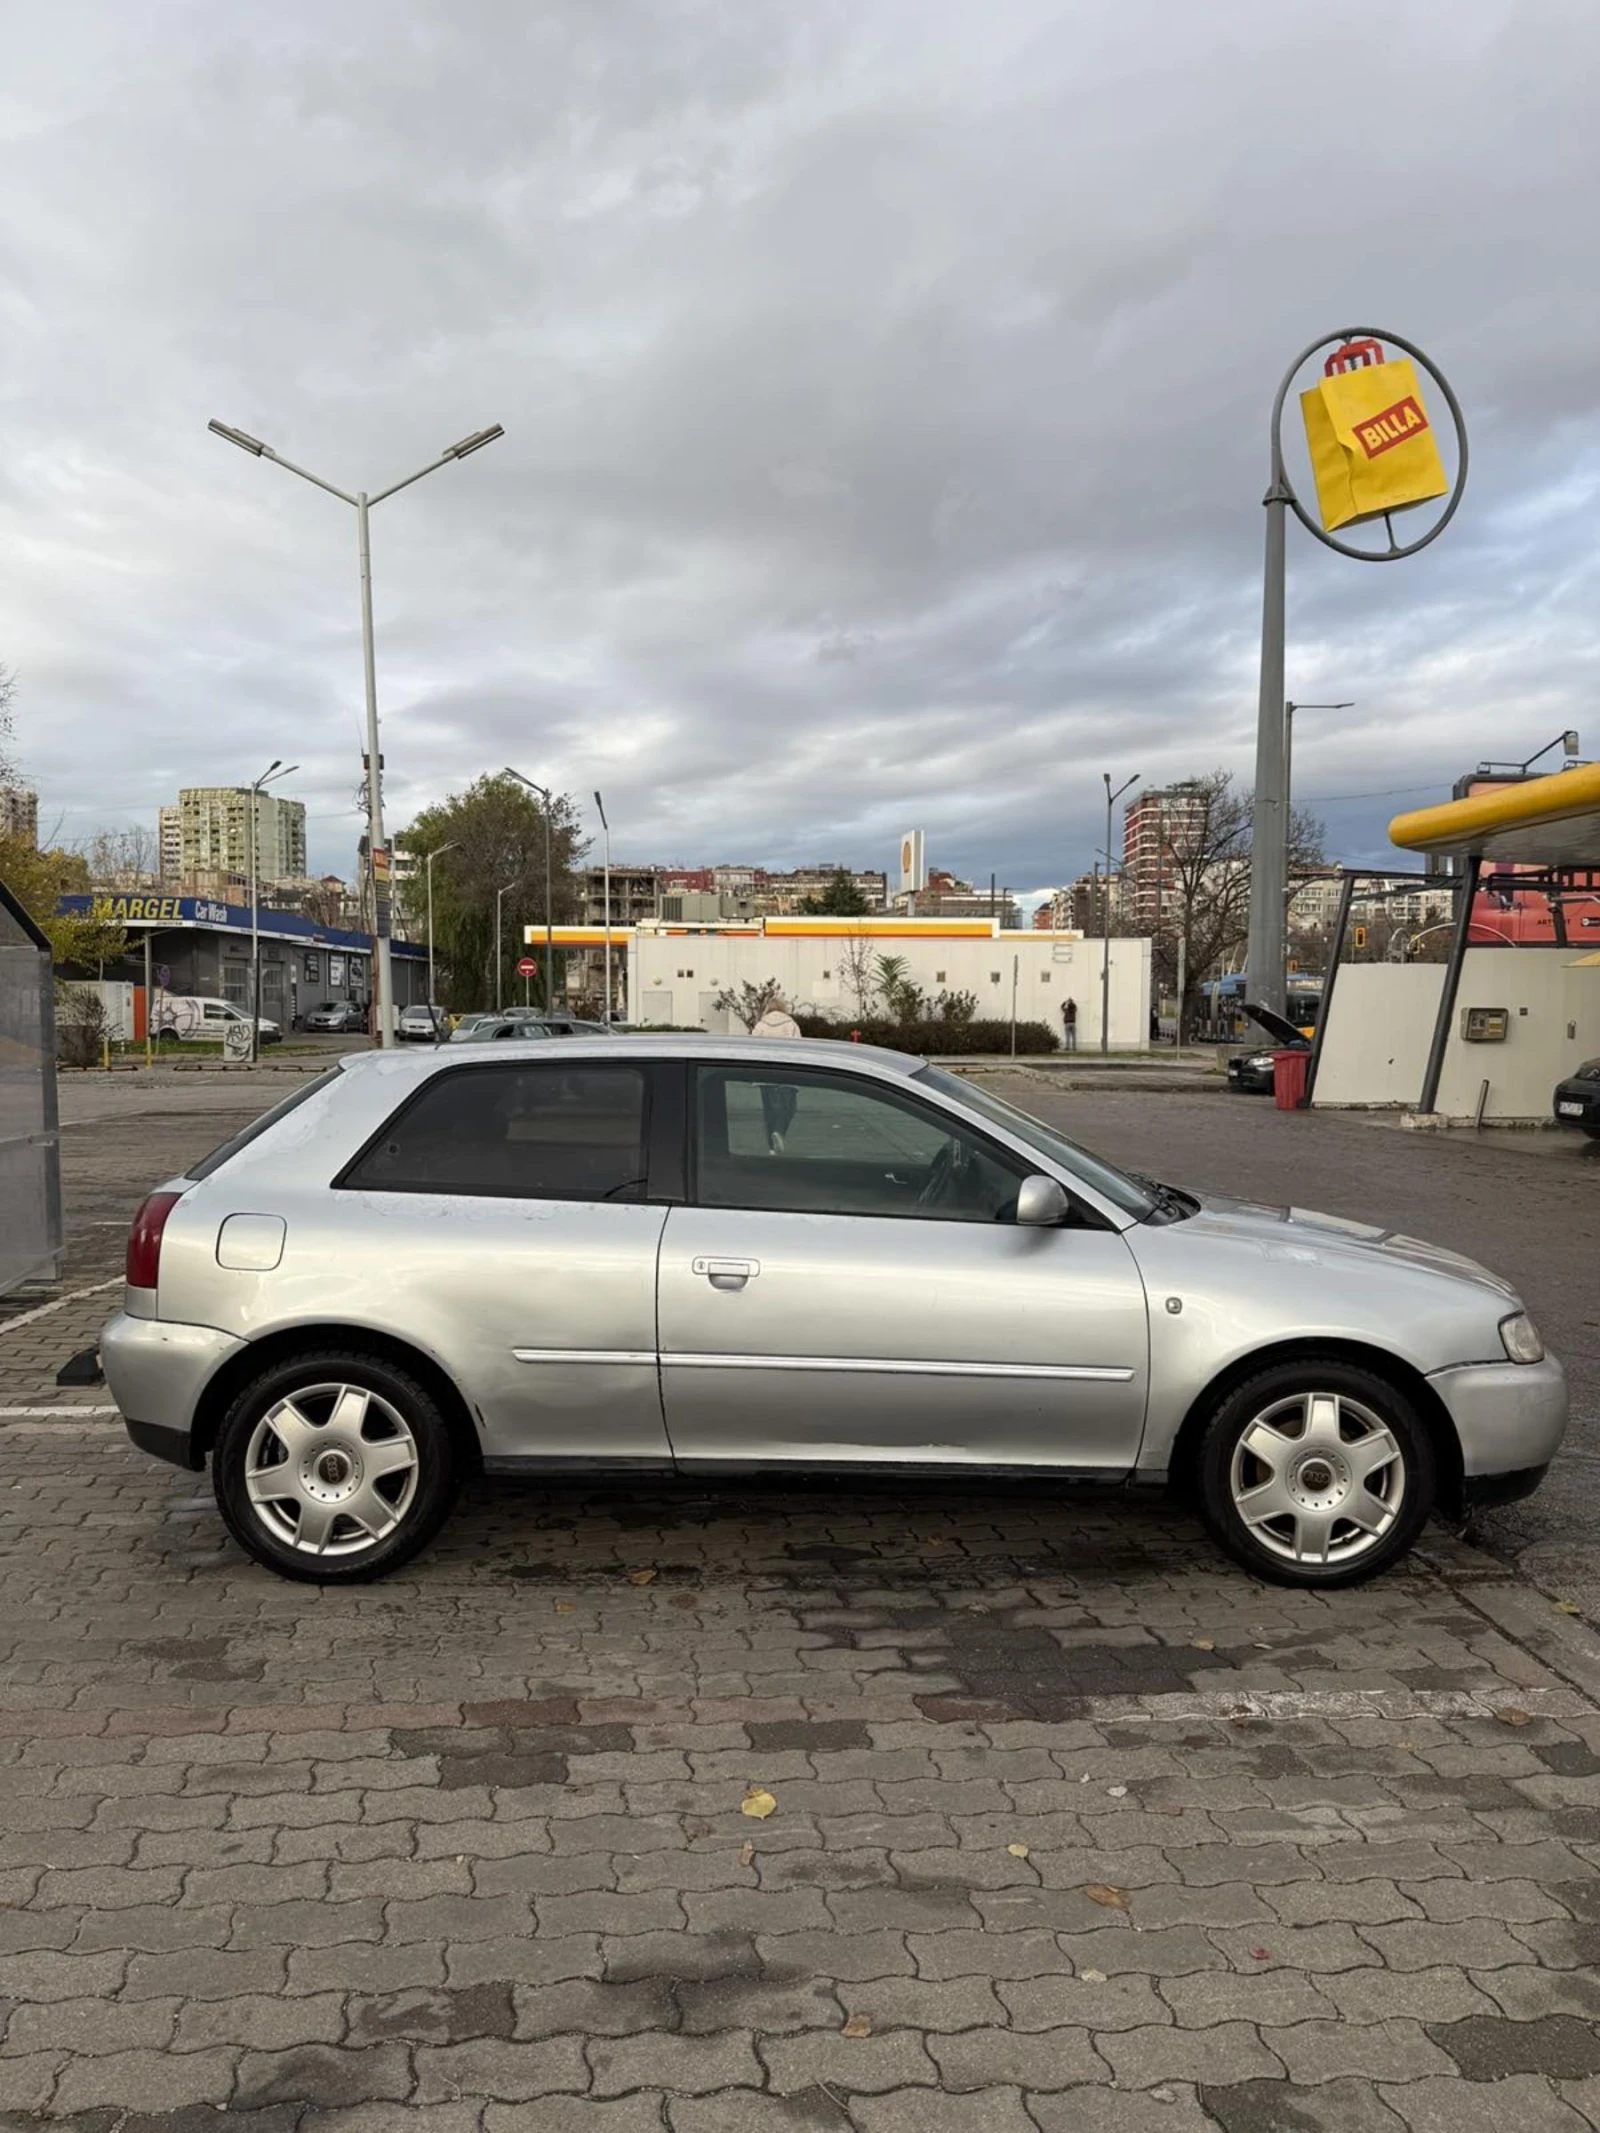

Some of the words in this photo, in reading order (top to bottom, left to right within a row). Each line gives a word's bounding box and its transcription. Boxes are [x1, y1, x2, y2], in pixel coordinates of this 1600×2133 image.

[1361, 406, 1421, 450] BILLA
[93, 896, 184, 919] MARGEL
[195, 901, 208, 919] Car
[208, 903, 228, 923] Wash
